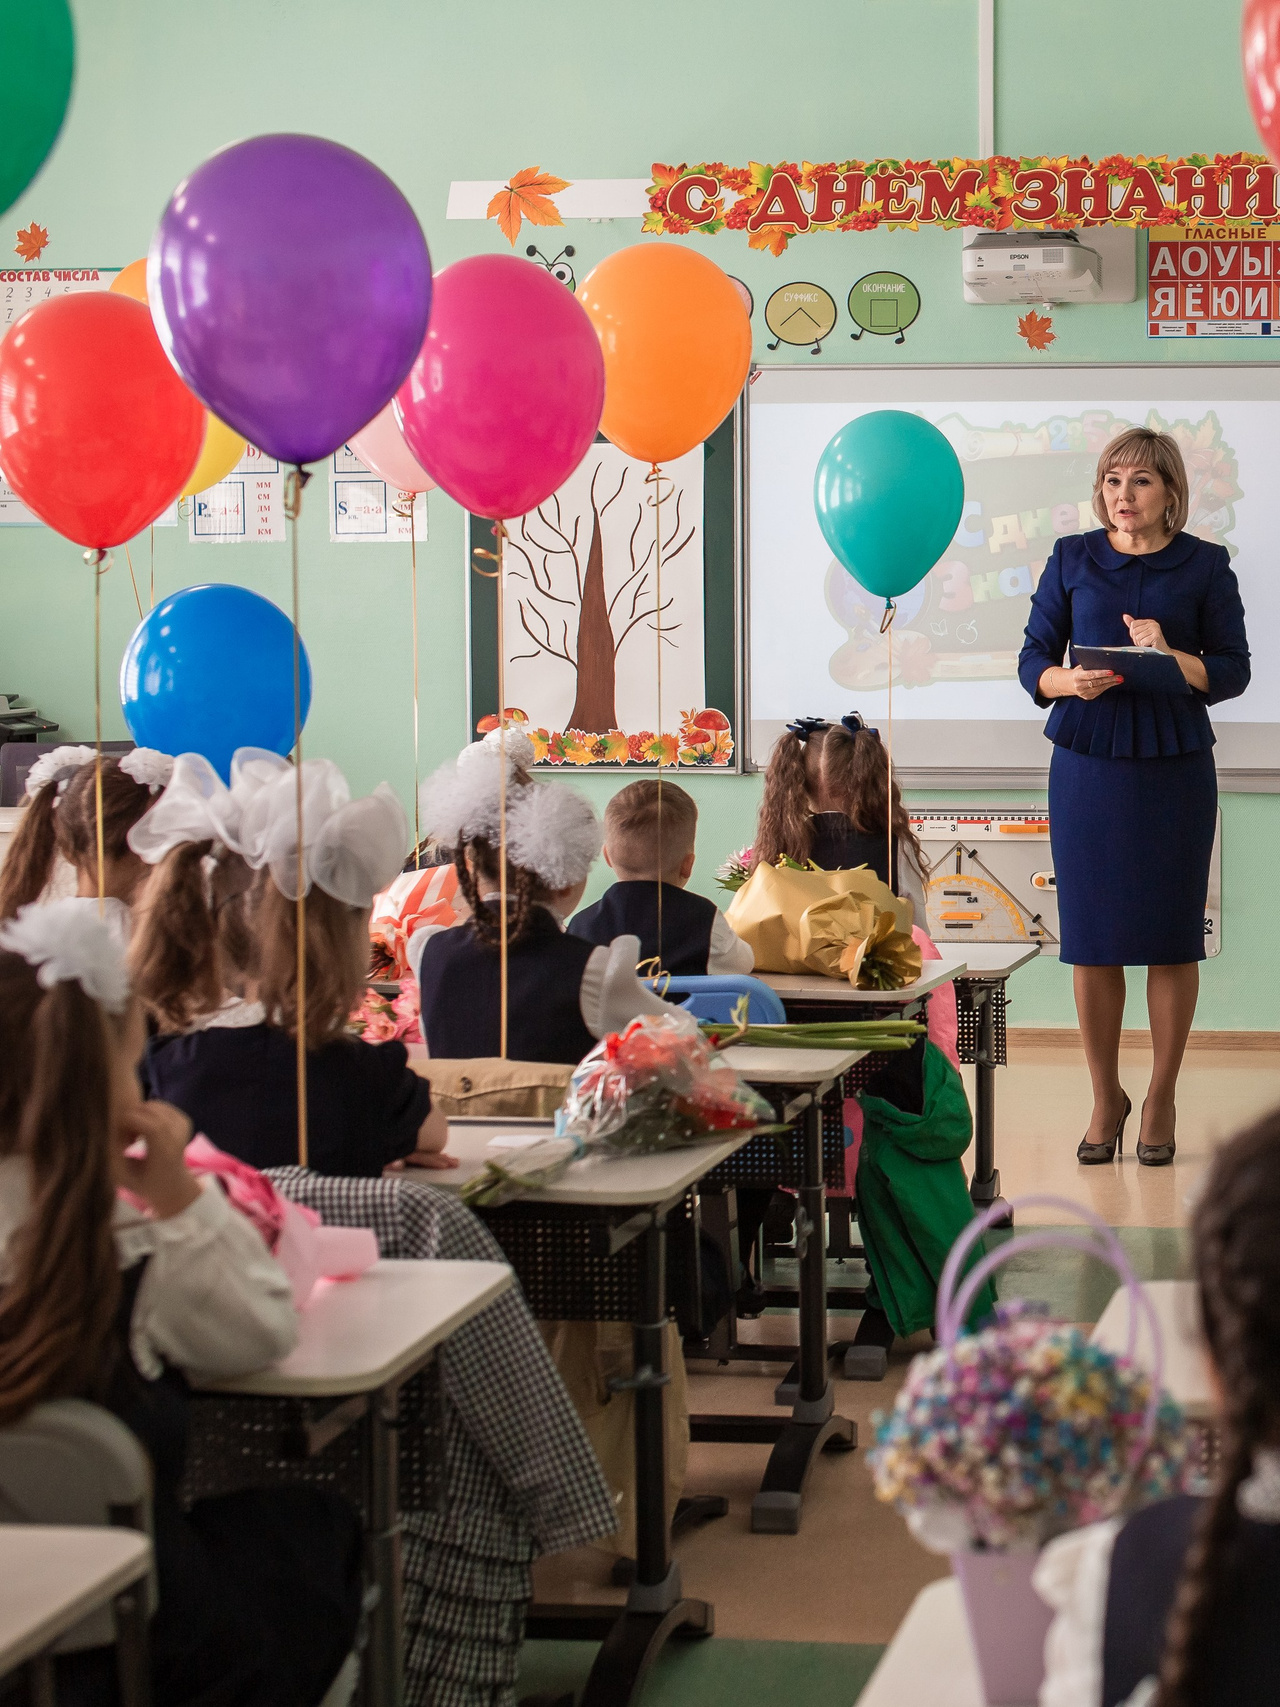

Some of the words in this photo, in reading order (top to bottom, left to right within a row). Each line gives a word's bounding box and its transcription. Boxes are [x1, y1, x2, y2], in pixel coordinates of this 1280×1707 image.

[666, 174, 721, 227] С
[747, 161, 984, 234] ДНЁМ
[1185, 228, 1267, 240] ГЛАСНЫЕ
[0, 271, 51, 282] СОСТАВ
[54, 270, 100, 281] ЧИСЛА
[862, 282, 906, 293] ОКОНЧАНИЕ
[784, 292, 819, 303] СУФФИКС
[917, 824, 922, 832] 2
[950, 824, 956, 832] 3
[984, 824, 989, 832] 4
